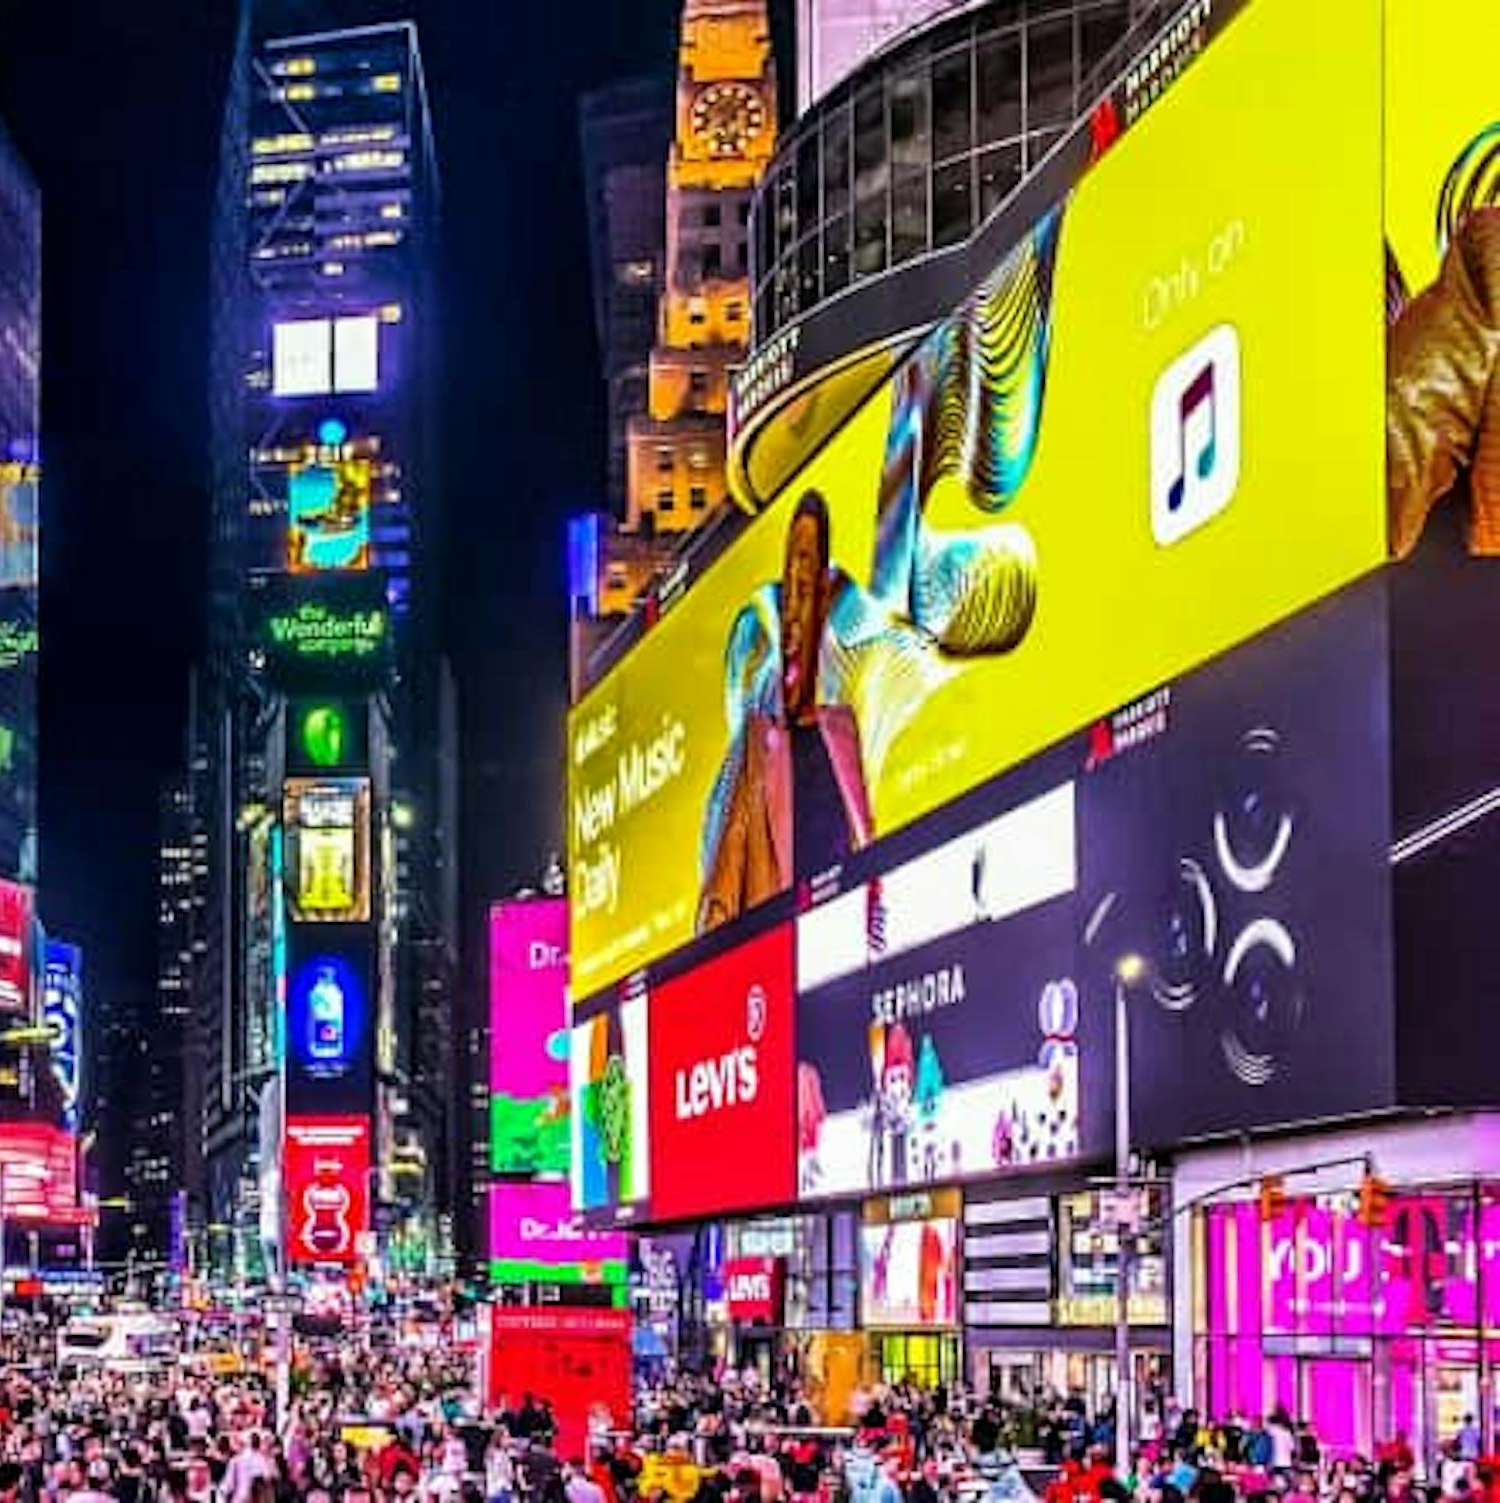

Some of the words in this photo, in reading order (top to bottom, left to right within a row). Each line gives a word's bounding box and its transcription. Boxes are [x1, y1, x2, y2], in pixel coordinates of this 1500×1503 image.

[1143, 258, 1200, 329] Only
[1207, 217, 1246, 273] on
[268, 610, 385, 642] Wonderful
[575, 776, 618, 853] New
[617, 713, 686, 816] Music
[574, 840, 621, 922] Daily
[872, 963, 965, 1025] SEPHORA
[1268, 1238, 1361, 1282] YOU
